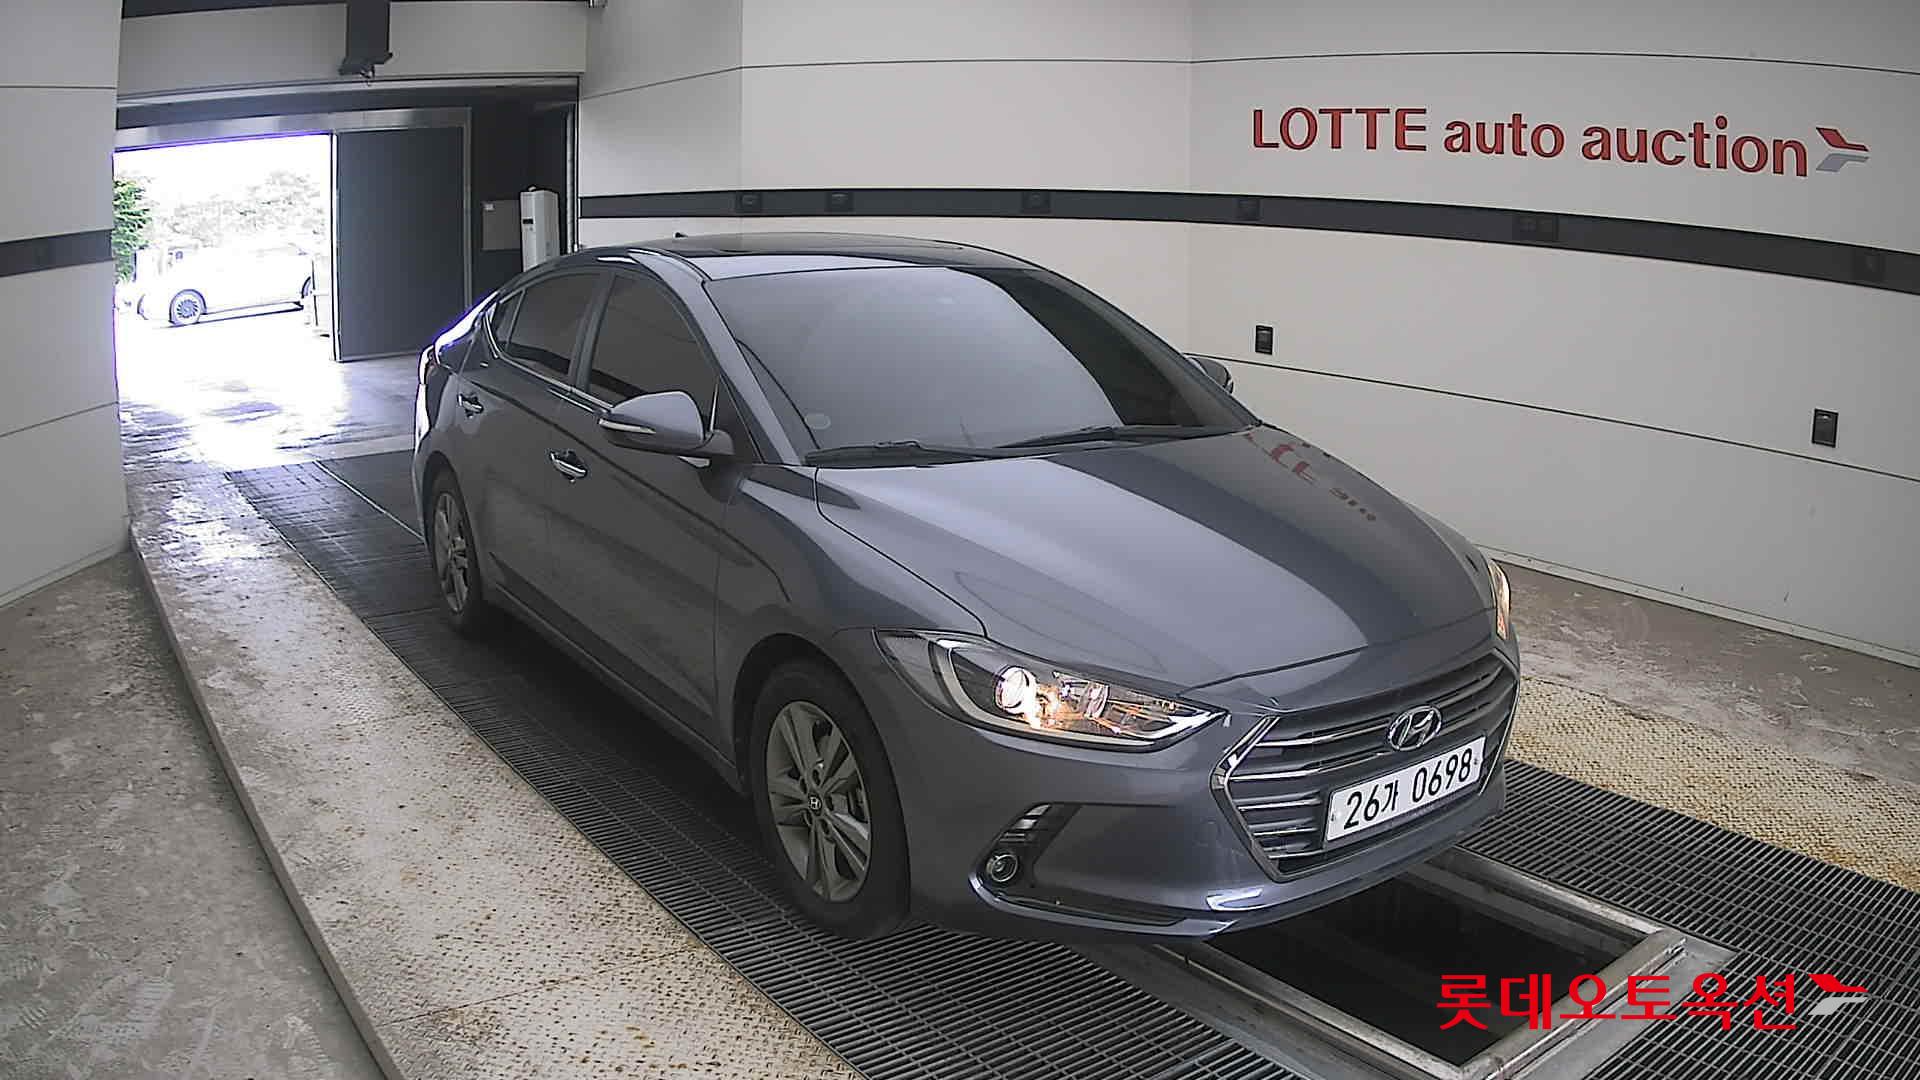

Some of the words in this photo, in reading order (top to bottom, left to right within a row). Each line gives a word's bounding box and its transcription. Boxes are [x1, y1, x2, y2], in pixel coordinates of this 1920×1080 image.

[1252, 107, 1428, 151] LOTTE
[1443, 112, 1565, 159] auto
[1581, 115, 1808, 177] auction
[1343, 780, 1399, 830] 26가
[1412, 747, 1473, 803] 0698
